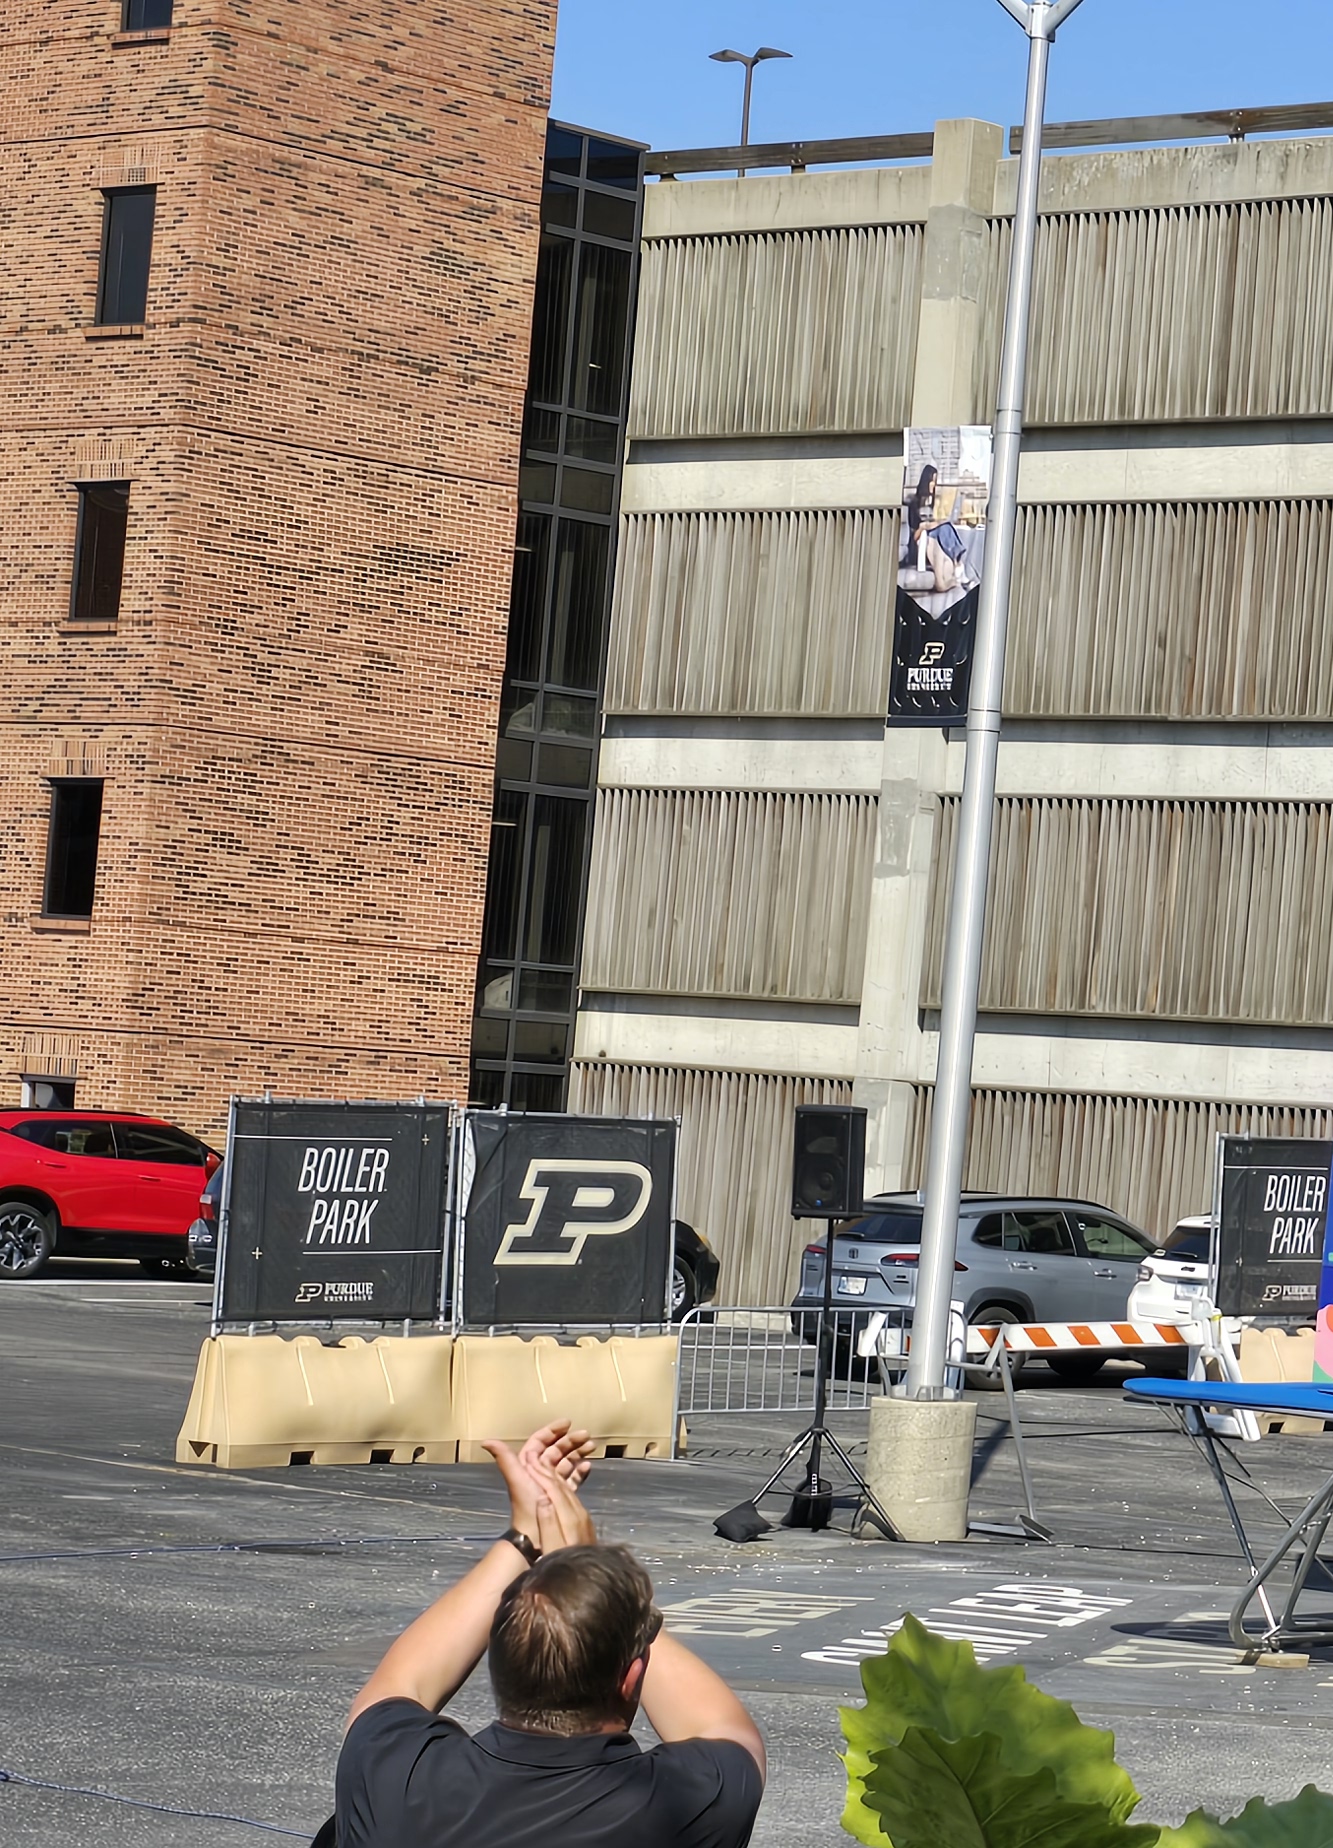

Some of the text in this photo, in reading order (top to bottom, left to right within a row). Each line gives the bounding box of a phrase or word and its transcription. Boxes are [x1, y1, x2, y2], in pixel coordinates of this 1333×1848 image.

[907, 667, 954, 683] PURDUE
[298, 1147, 389, 1193] BOILER
[1263, 1174, 1327, 1212] BOILER
[305, 1199, 380, 1245] PARK
[1269, 1216, 1320, 1254] PARK
[324, 1282, 375, 1295] PURDUE
[927, 1583, 1135, 1628] LEAP
